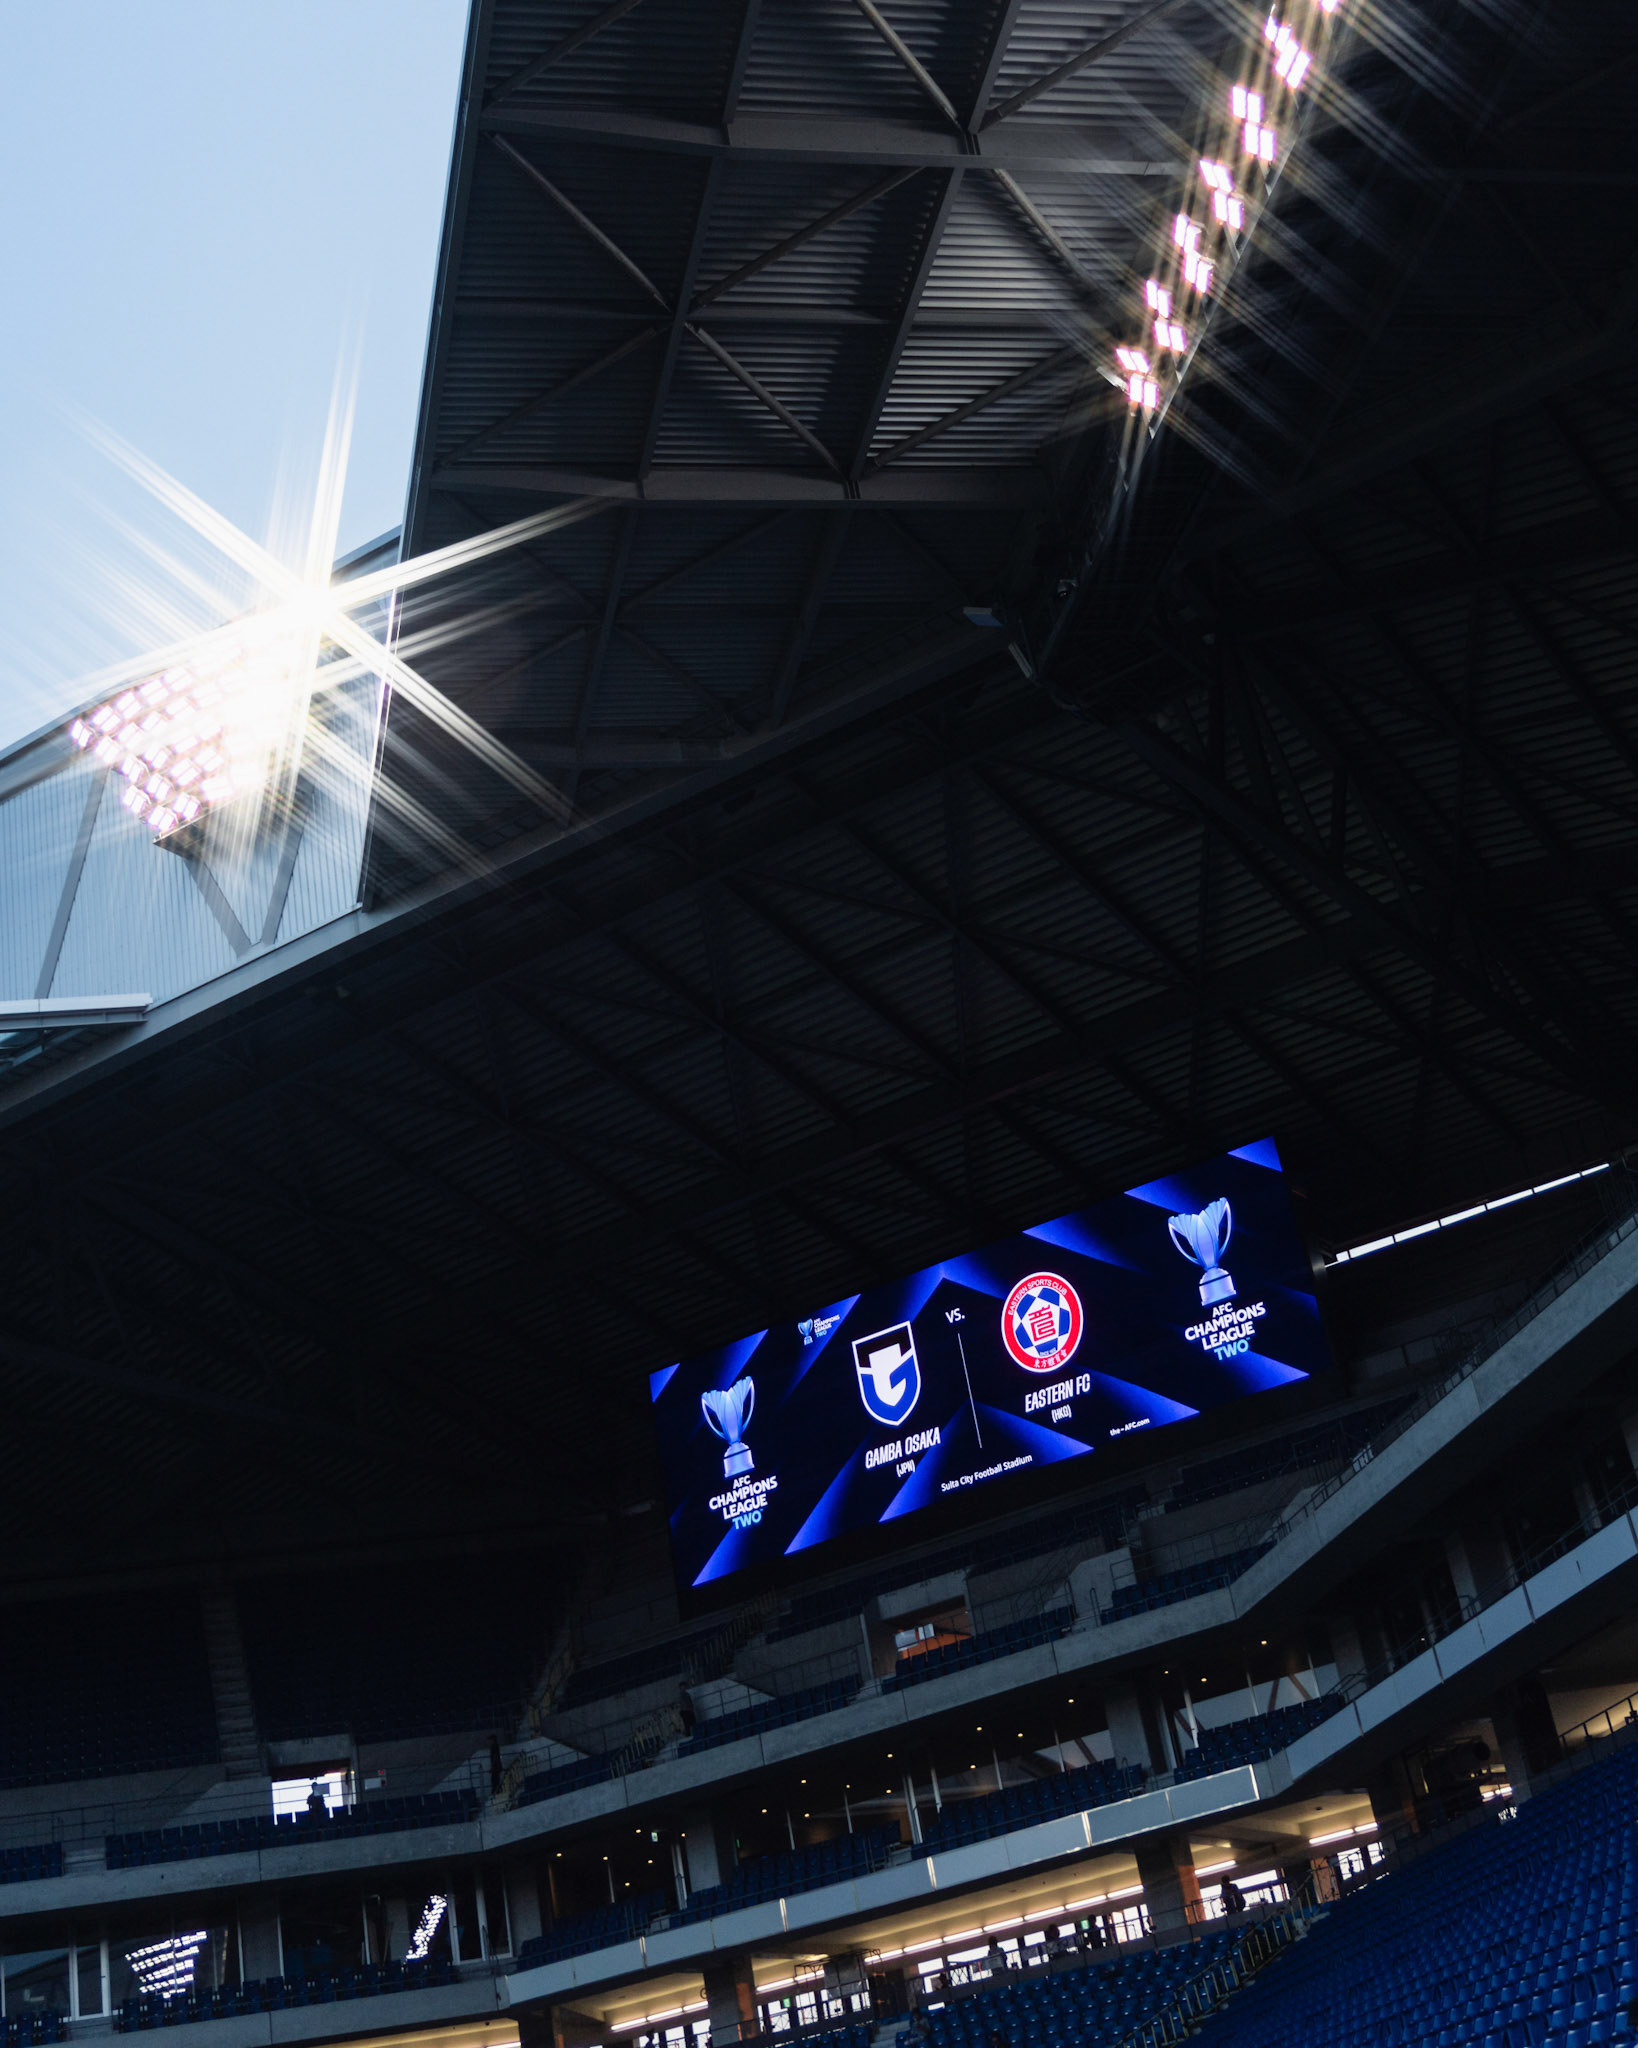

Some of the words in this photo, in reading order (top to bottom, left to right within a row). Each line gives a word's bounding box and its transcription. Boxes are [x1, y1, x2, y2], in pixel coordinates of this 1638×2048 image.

[1008, 1286, 1028, 1316] EASTERN
[1027, 1279, 1052, 1290] SPORTS
[1051, 1281, 1068, 1296] CLUB
[1212, 1302, 1233, 1318] AFC
[945, 1307, 965, 1323] VS.
[1184, 1301, 1267, 1341] CHAMPIONS
[1201, 1320, 1255, 1351] LEAGUE
[1213, 1338, 1248, 1361] TWO
[1025, 1378, 1074, 1413] EASTERN
[1076, 1373, 1091, 1396] FC
[1051, 1404, 1072, 1423] (HKG)
[865, 1439, 903, 1469] GAMBA
[904, 1426, 941, 1455] OSAKA
[896, 1459, 916, 1477] (JPN)
[941, 1479, 959, 1492] Suita
[960, 1474, 974, 1485] City
[974, 1463, 1003, 1481] Football
[1003, 1454, 1033, 1471] Stadium
[708, 1475, 778, 1511] CHAMPIONS
[733, 1475, 751, 1490] AFC
[722, 1493, 768, 1520] LEAGUE
[732, 1509, 762, 1530] TWO
